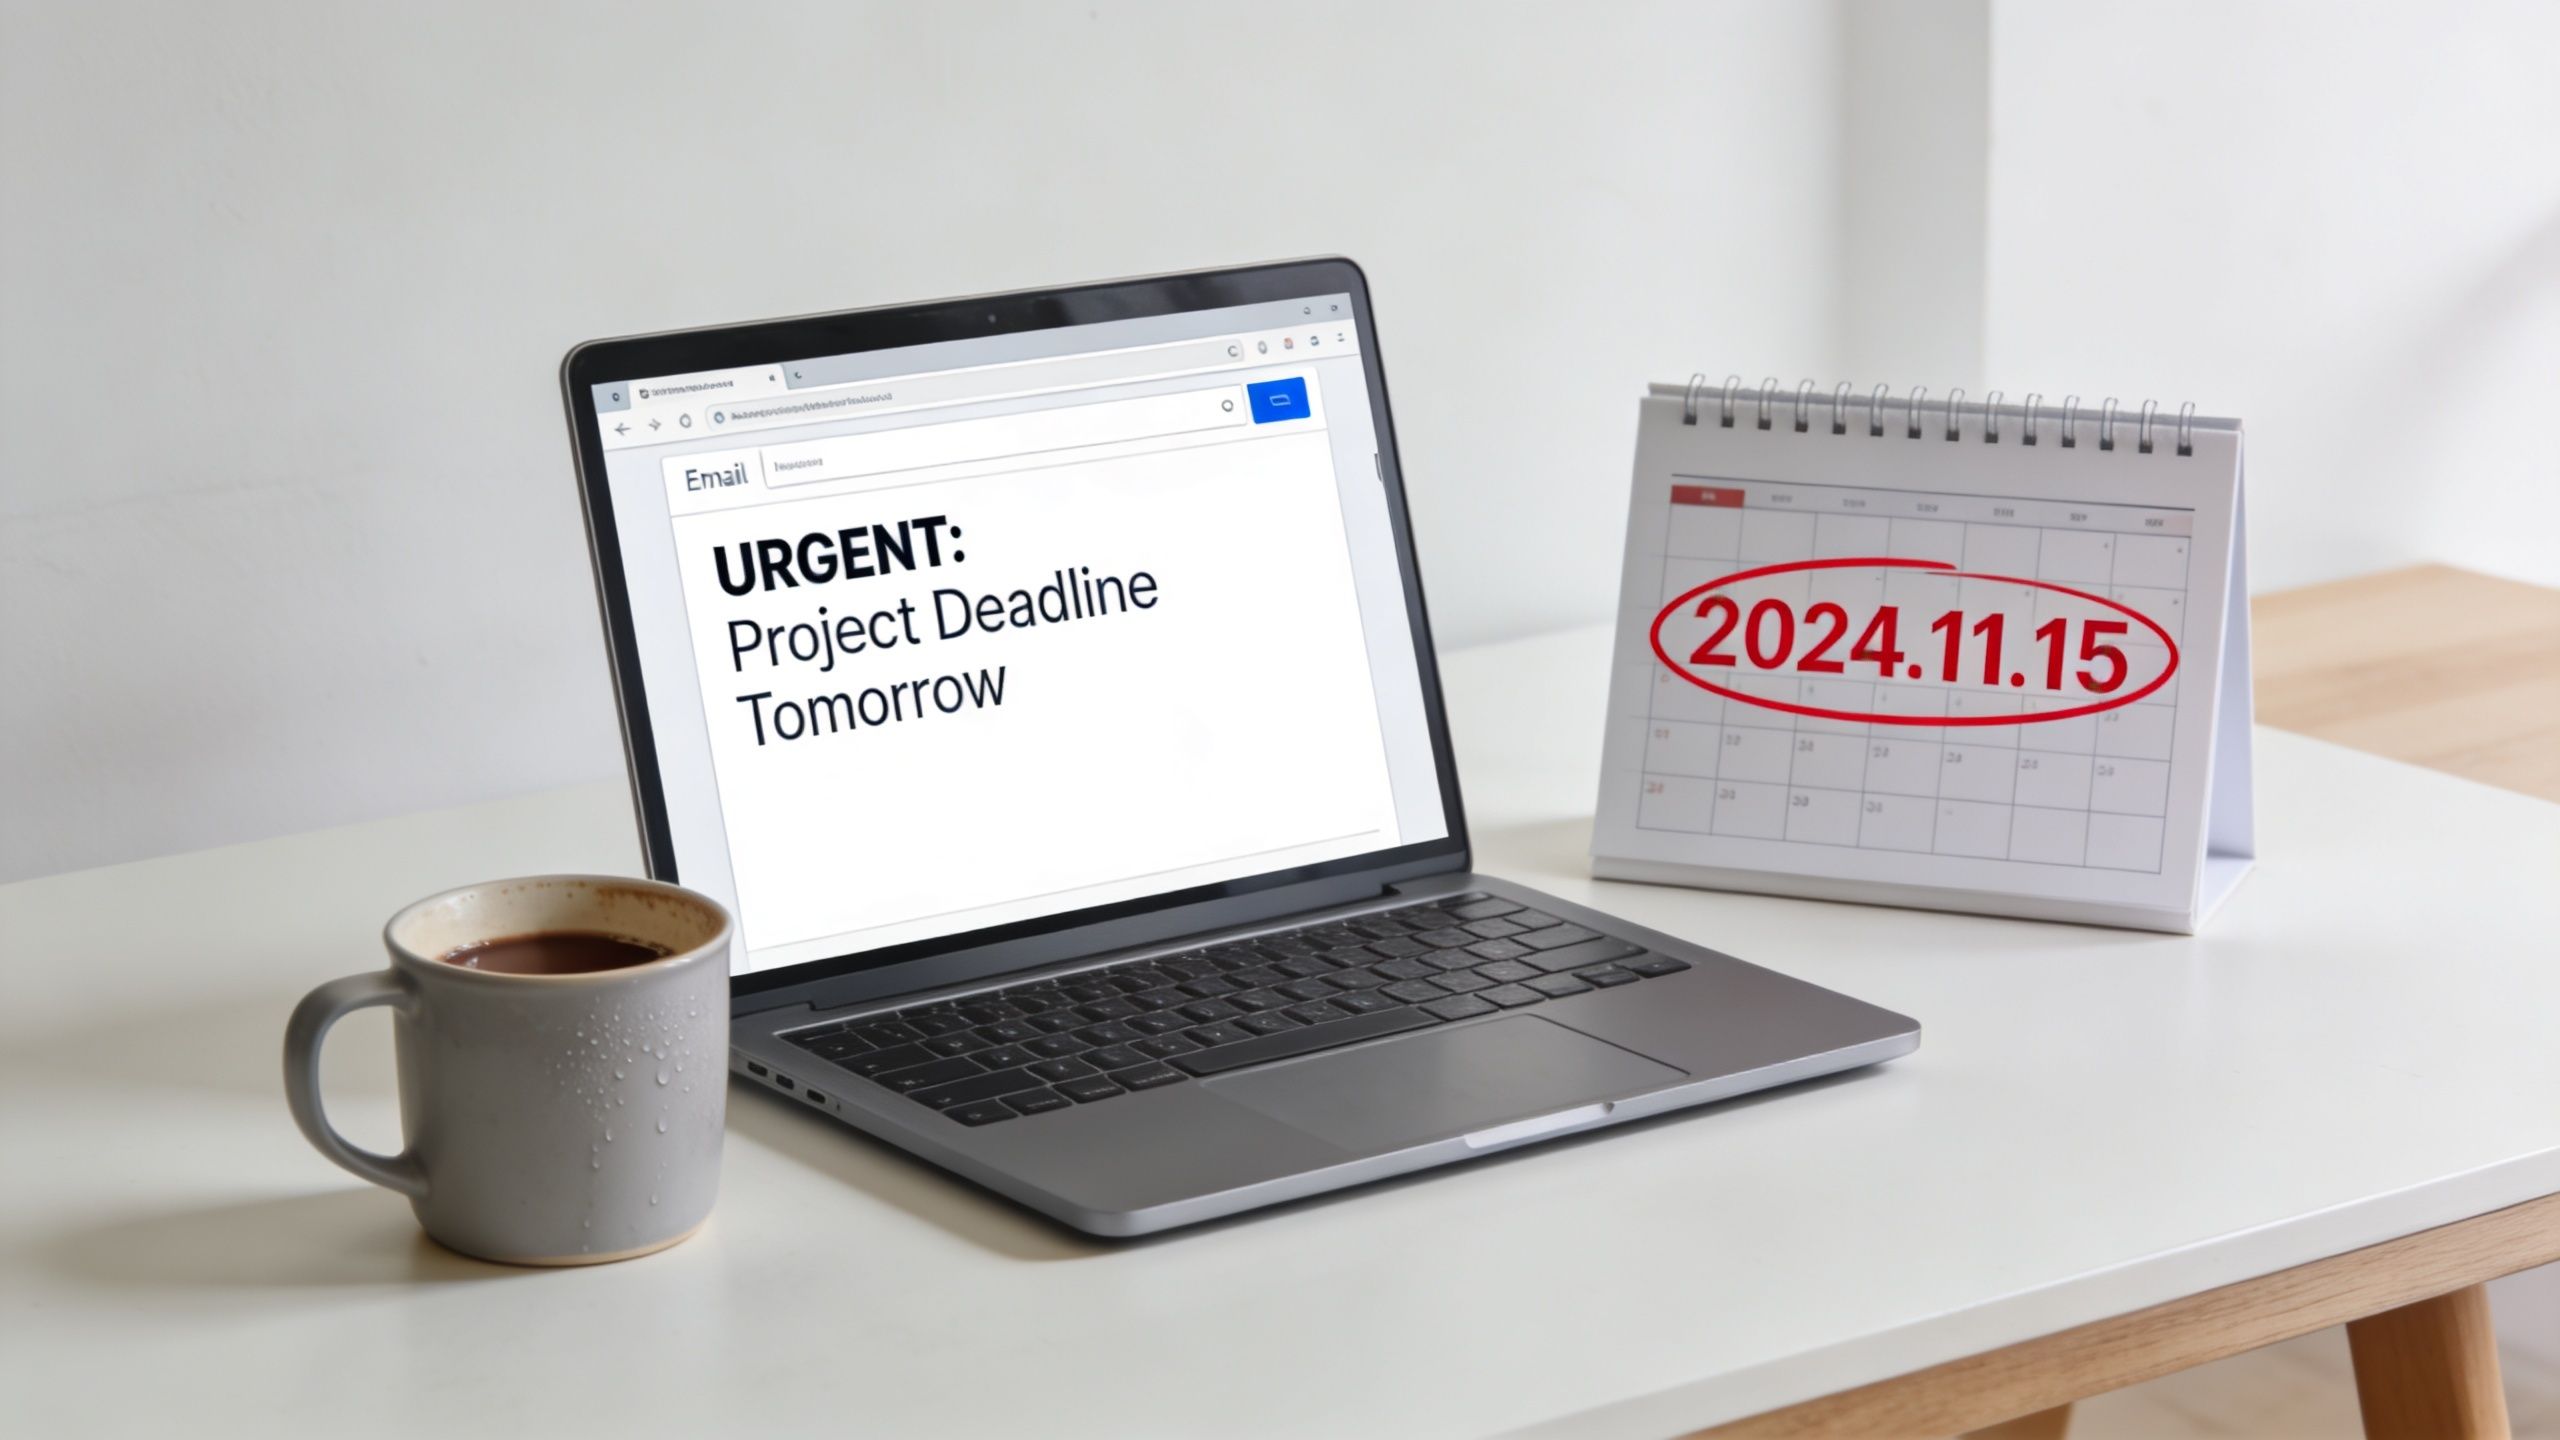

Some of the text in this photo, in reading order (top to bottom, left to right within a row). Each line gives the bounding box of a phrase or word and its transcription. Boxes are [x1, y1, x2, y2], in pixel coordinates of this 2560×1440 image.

[684, 462, 749, 491] Email
[713, 515, 967, 596] URGENT:
[727, 567, 1158, 673] Project Deadline
[1690, 596, 2128, 694] 2024.11.15
[736, 665, 1006, 746] Tomorrow
